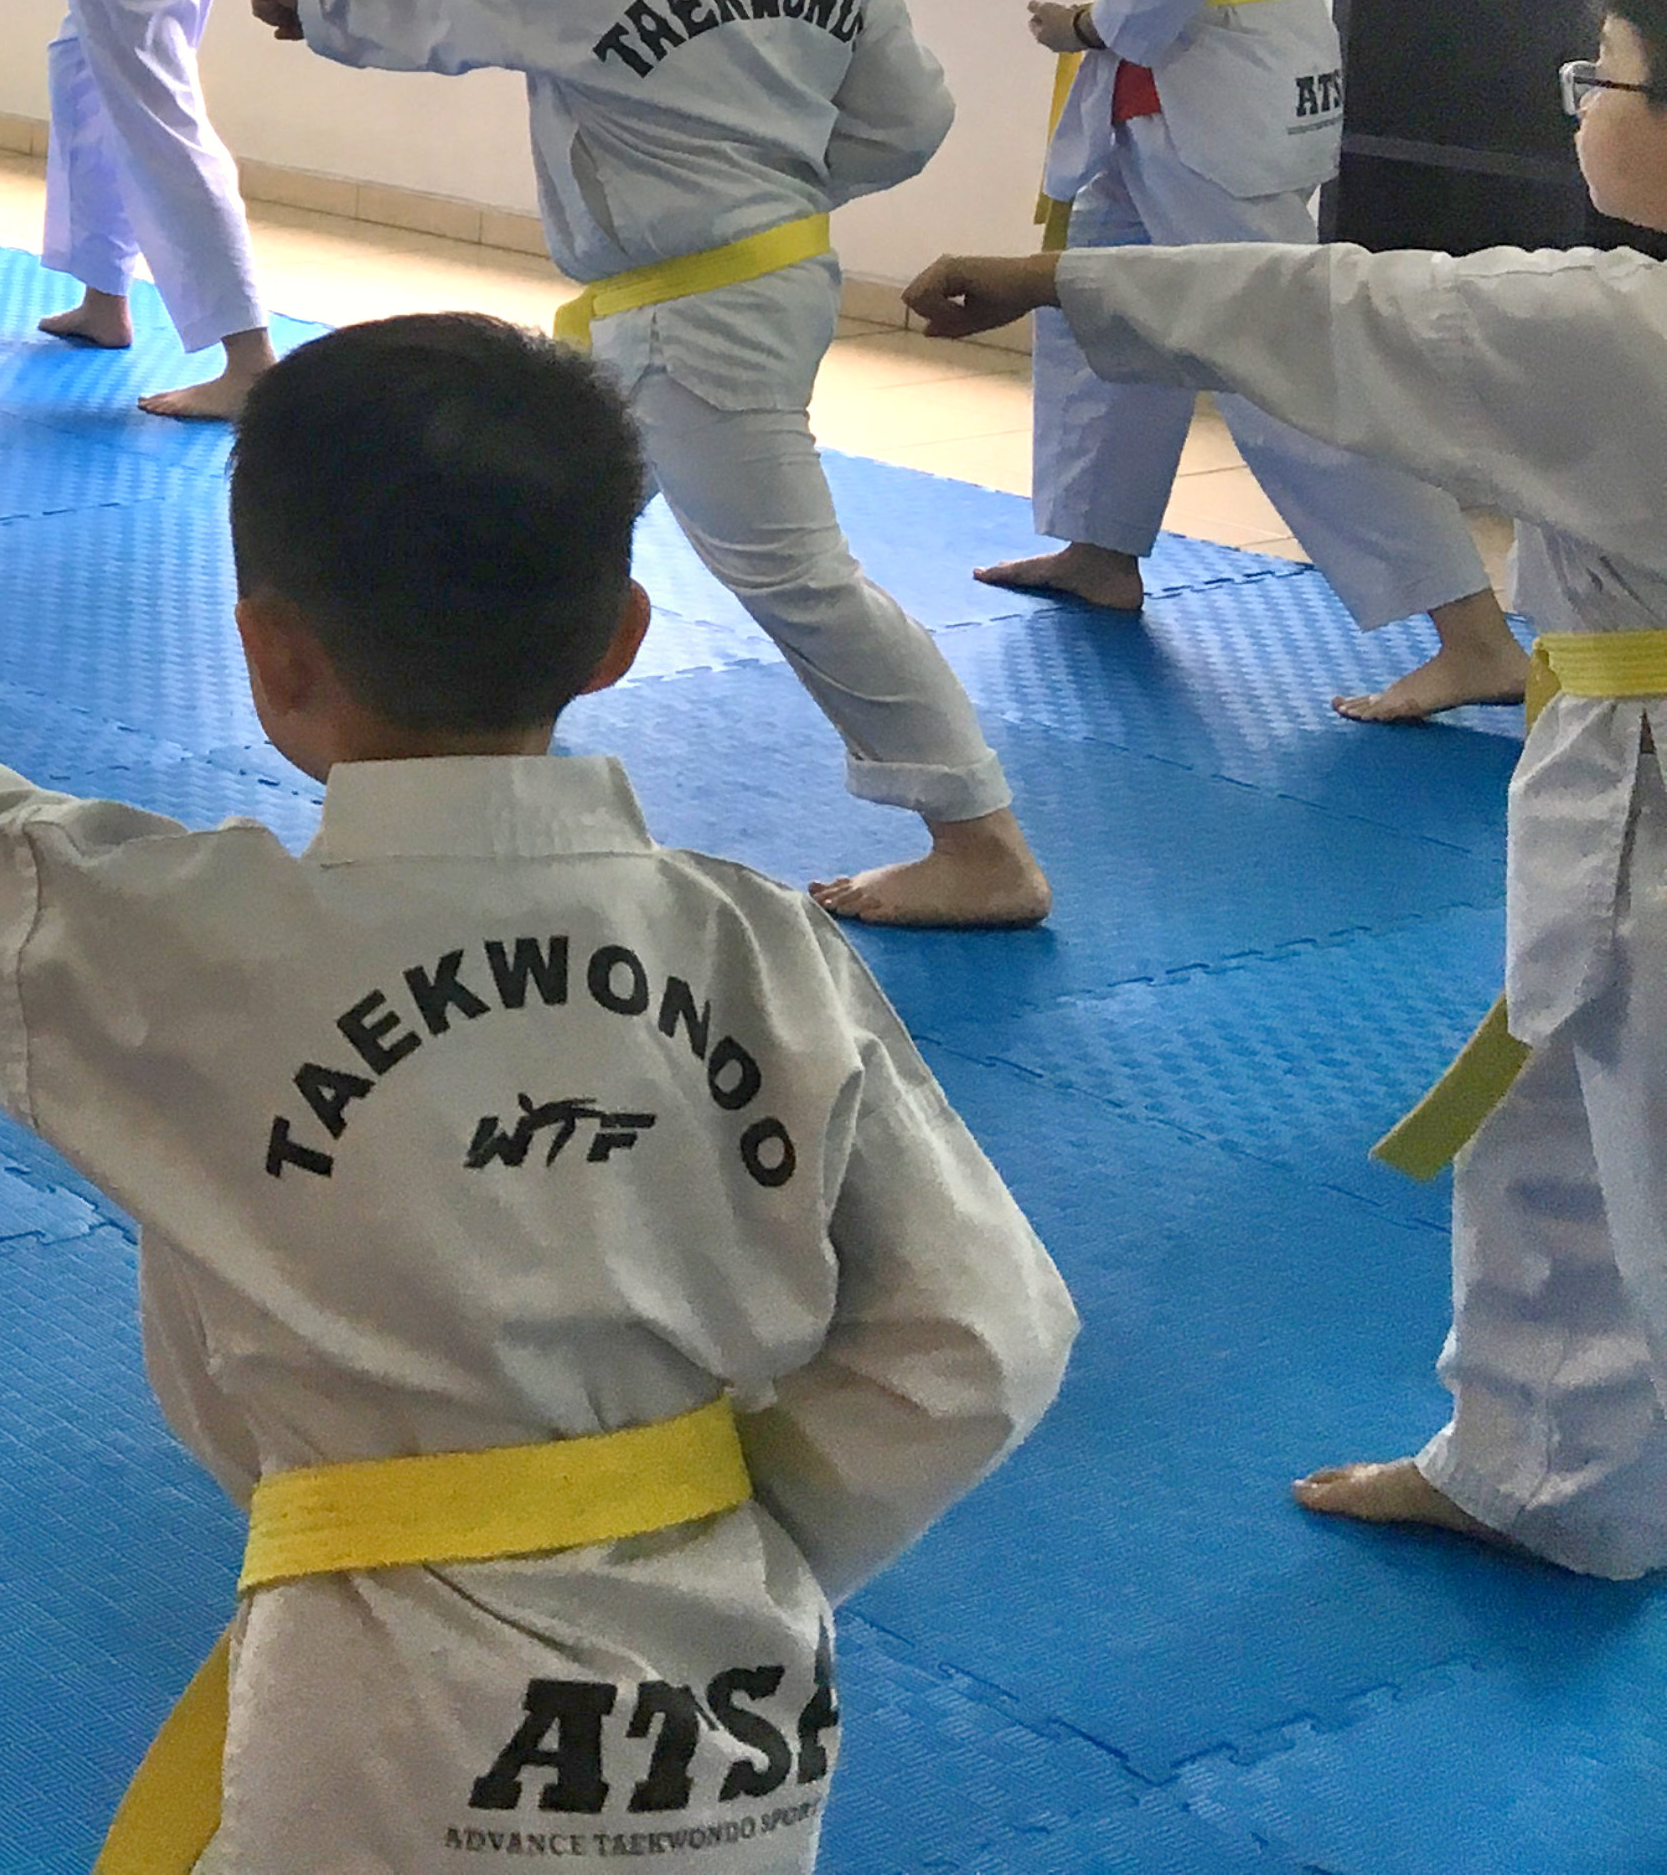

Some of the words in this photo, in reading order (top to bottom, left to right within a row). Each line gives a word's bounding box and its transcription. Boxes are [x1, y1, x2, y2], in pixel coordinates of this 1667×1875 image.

[266, 935, 796, 1188] TAEKWONDO
[464, 1093, 657, 1169] WTF
[444, 1827, 583, 1856] ADVANCE
[593, 1816, 757, 1857] TAEKWONDO
